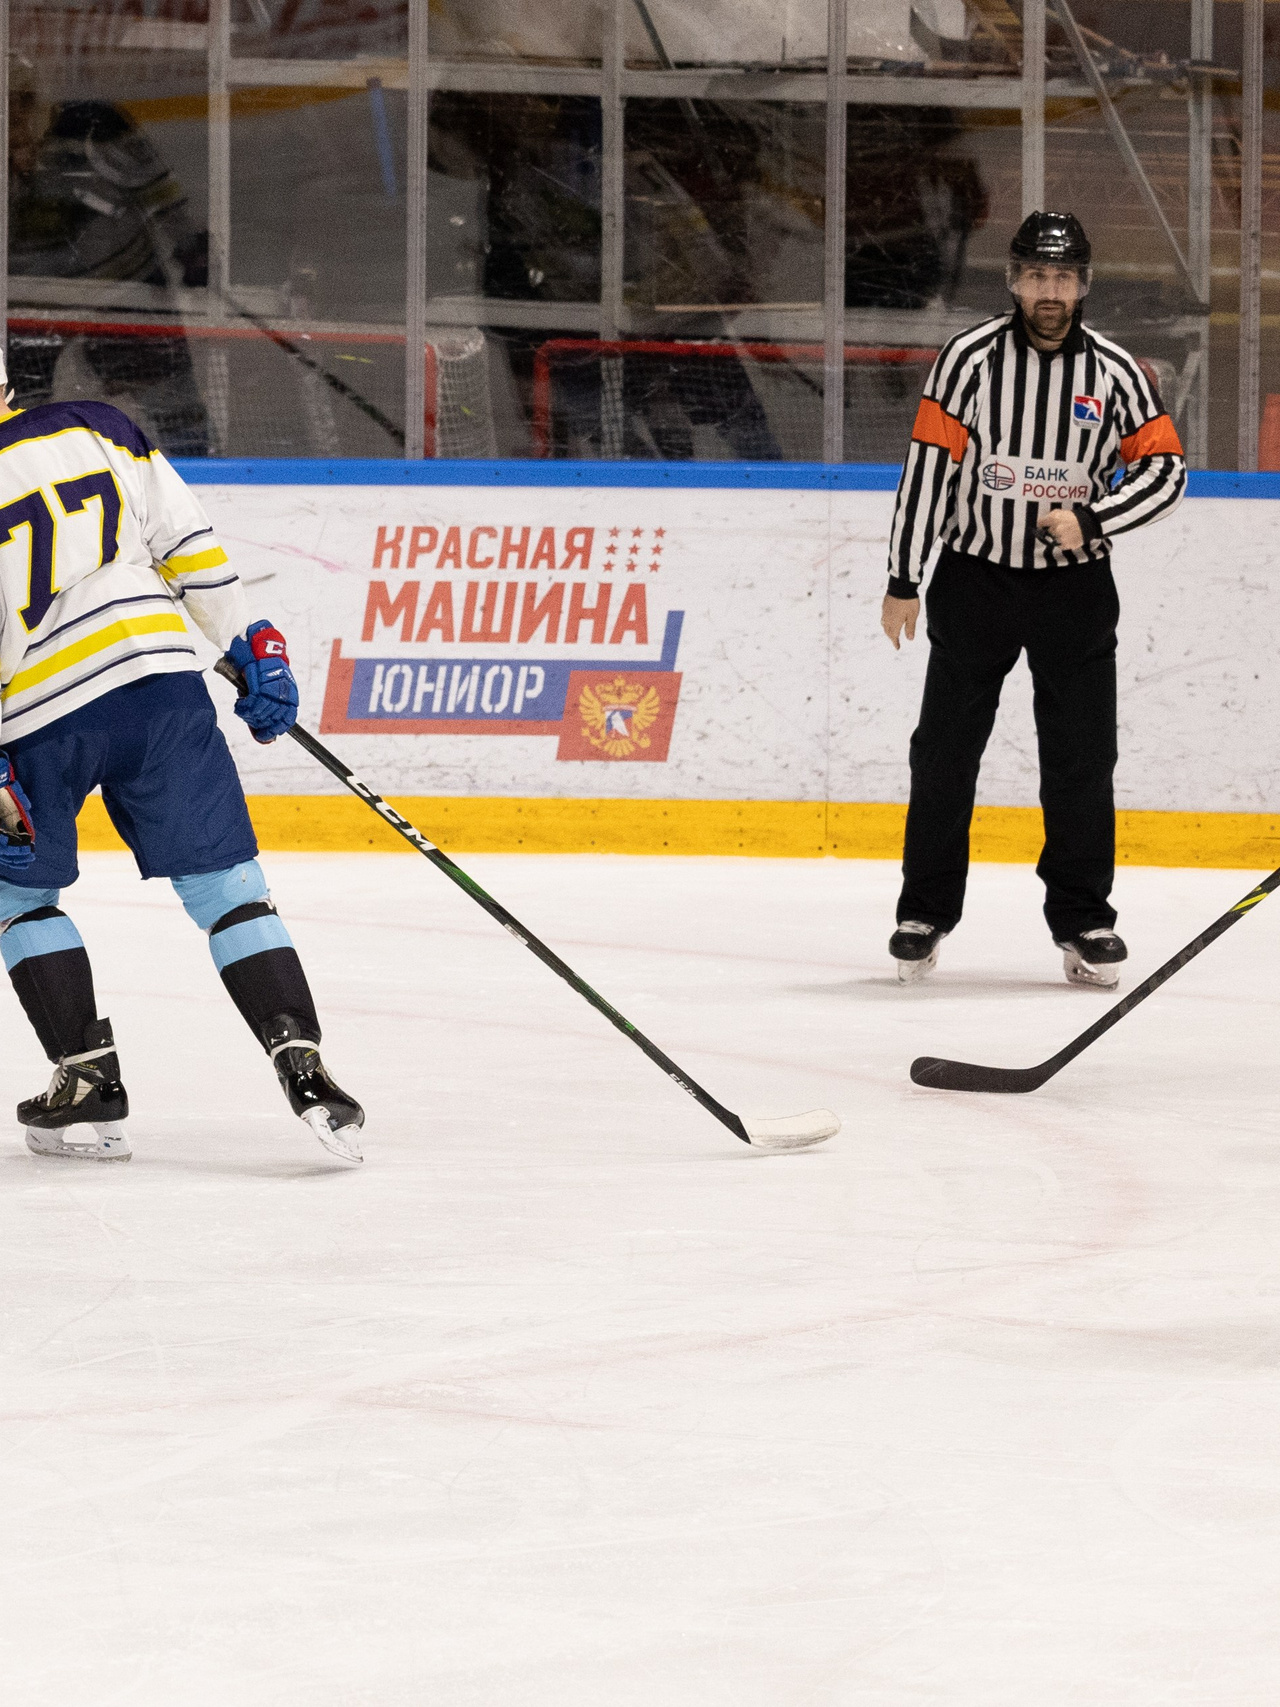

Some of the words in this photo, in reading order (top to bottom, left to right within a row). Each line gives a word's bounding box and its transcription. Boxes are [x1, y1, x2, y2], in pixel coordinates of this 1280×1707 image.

[1022, 483, 1088, 499] РОССИЯ
[1024, 465, 1069, 481] БАНК
[371, 525, 595, 570] КРАСНАЯ
[360, 580, 649, 645] МАШИНА
[367, 663, 546, 715] ЮНИОР
[347, 775, 437, 851] CCM
[669, 1072, 697, 1097] CCM
